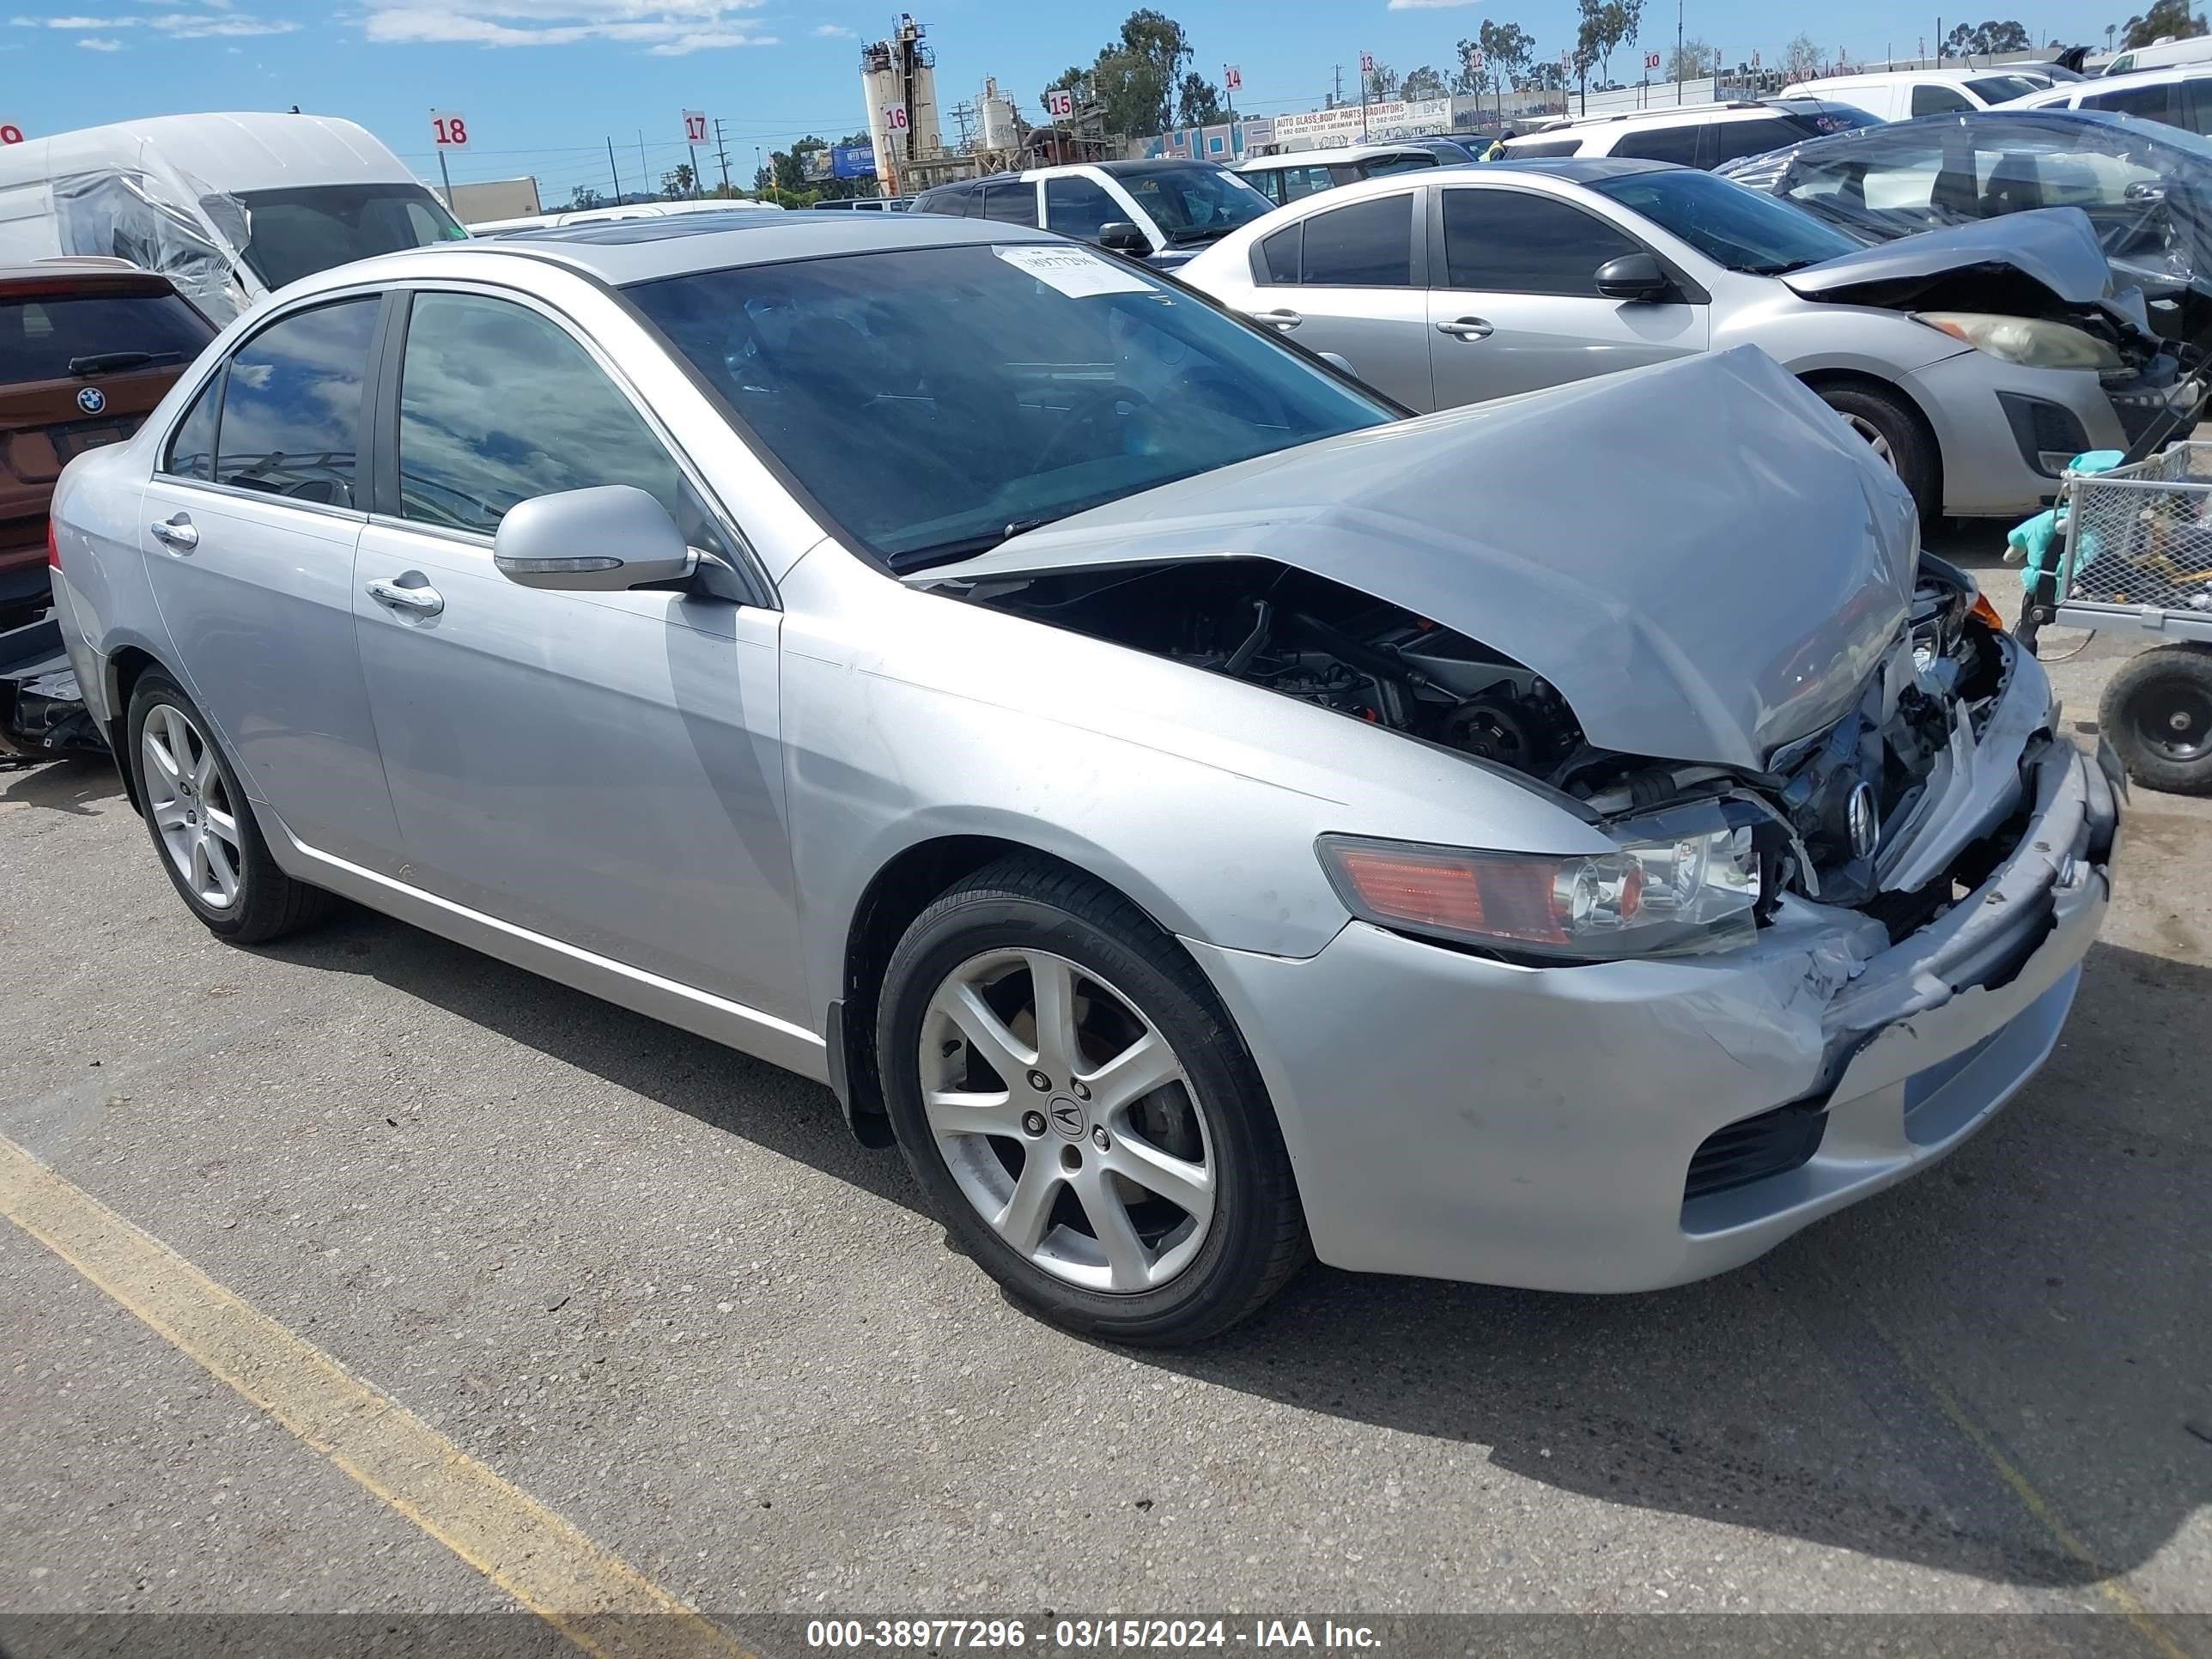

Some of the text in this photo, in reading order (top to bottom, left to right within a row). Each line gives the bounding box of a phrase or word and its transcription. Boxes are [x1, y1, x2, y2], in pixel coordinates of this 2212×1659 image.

[1361, 56, 1373, 72] 13
[1473, 53, 1483, 68] 12
[1563, 56, 1571, 69] 11
[1644, 54, 1660, 69] 10
[1225, 70, 1242, 88] 14
[1050, 95, 1071, 115] 15
[1423, 102, 1446, 114] BPC
[885, 108, 907, 130] 16
[1276, 118, 1293, 128] AUTO
[1296, 114, 1317, 125] GLASS
[1320, 112, 1338, 123] BODY
[1340, 109, 1362, 120] PARTS
[1365, 104, 1404, 117] RADIATORS
[0, 125, 24, 145] 9
[433, 118, 467, 144] 18
[686, 117, 706, 140] 17
[1328, 121, 1352, 131] SHERMAN
